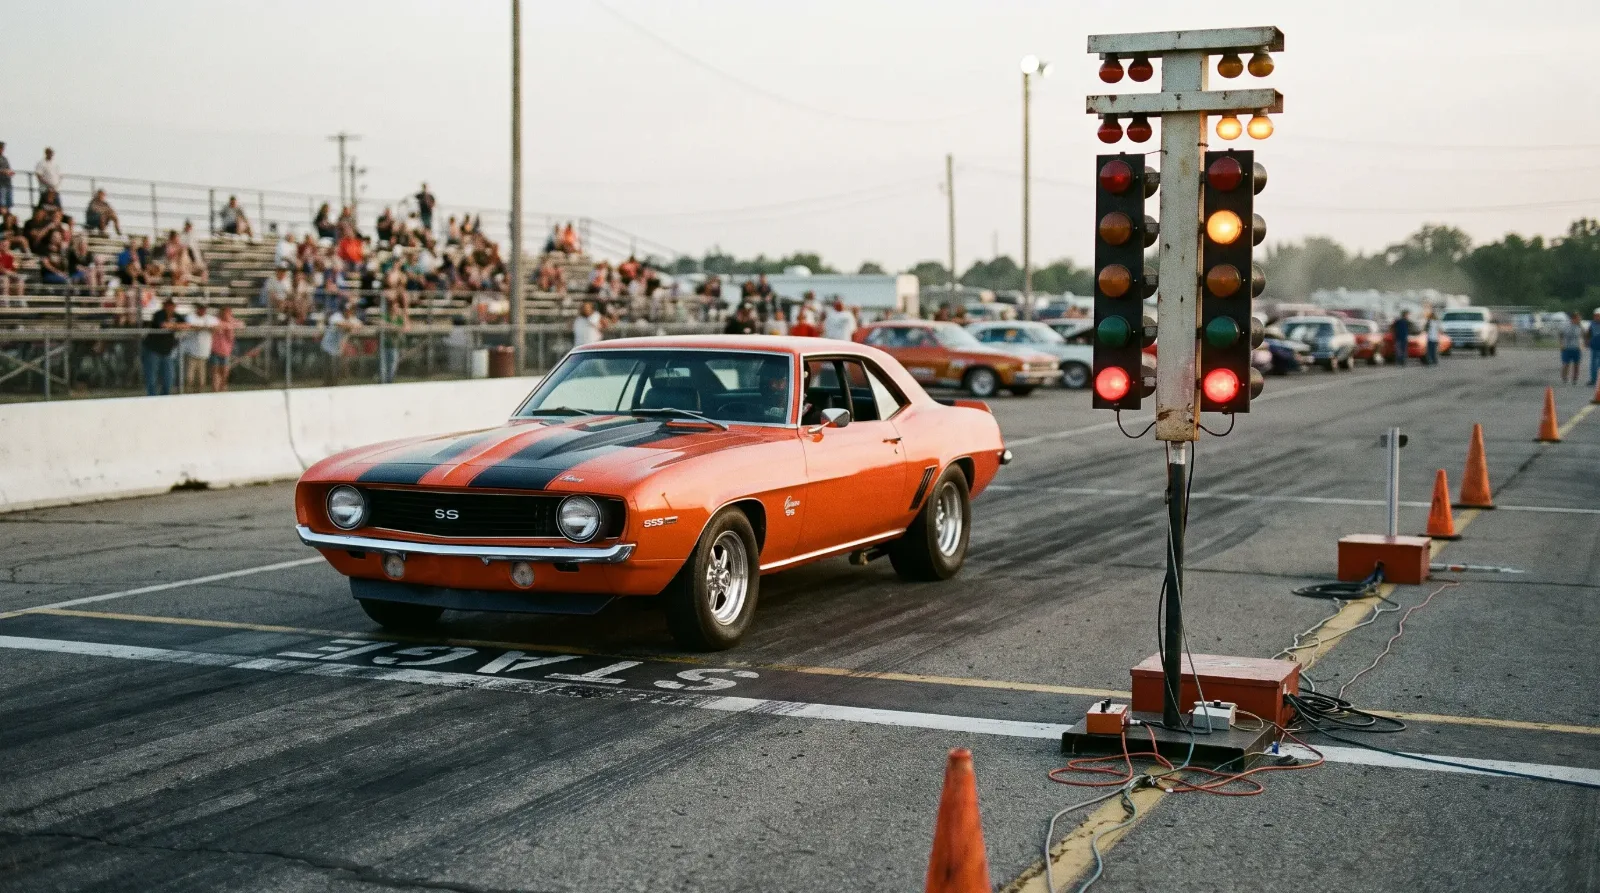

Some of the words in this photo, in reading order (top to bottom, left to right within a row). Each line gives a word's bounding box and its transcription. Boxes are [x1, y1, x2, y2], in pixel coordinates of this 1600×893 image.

[434, 508, 459, 520] SS
[643, 517, 664, 528] SSS
[276, 638, 760, 691] STAGE
